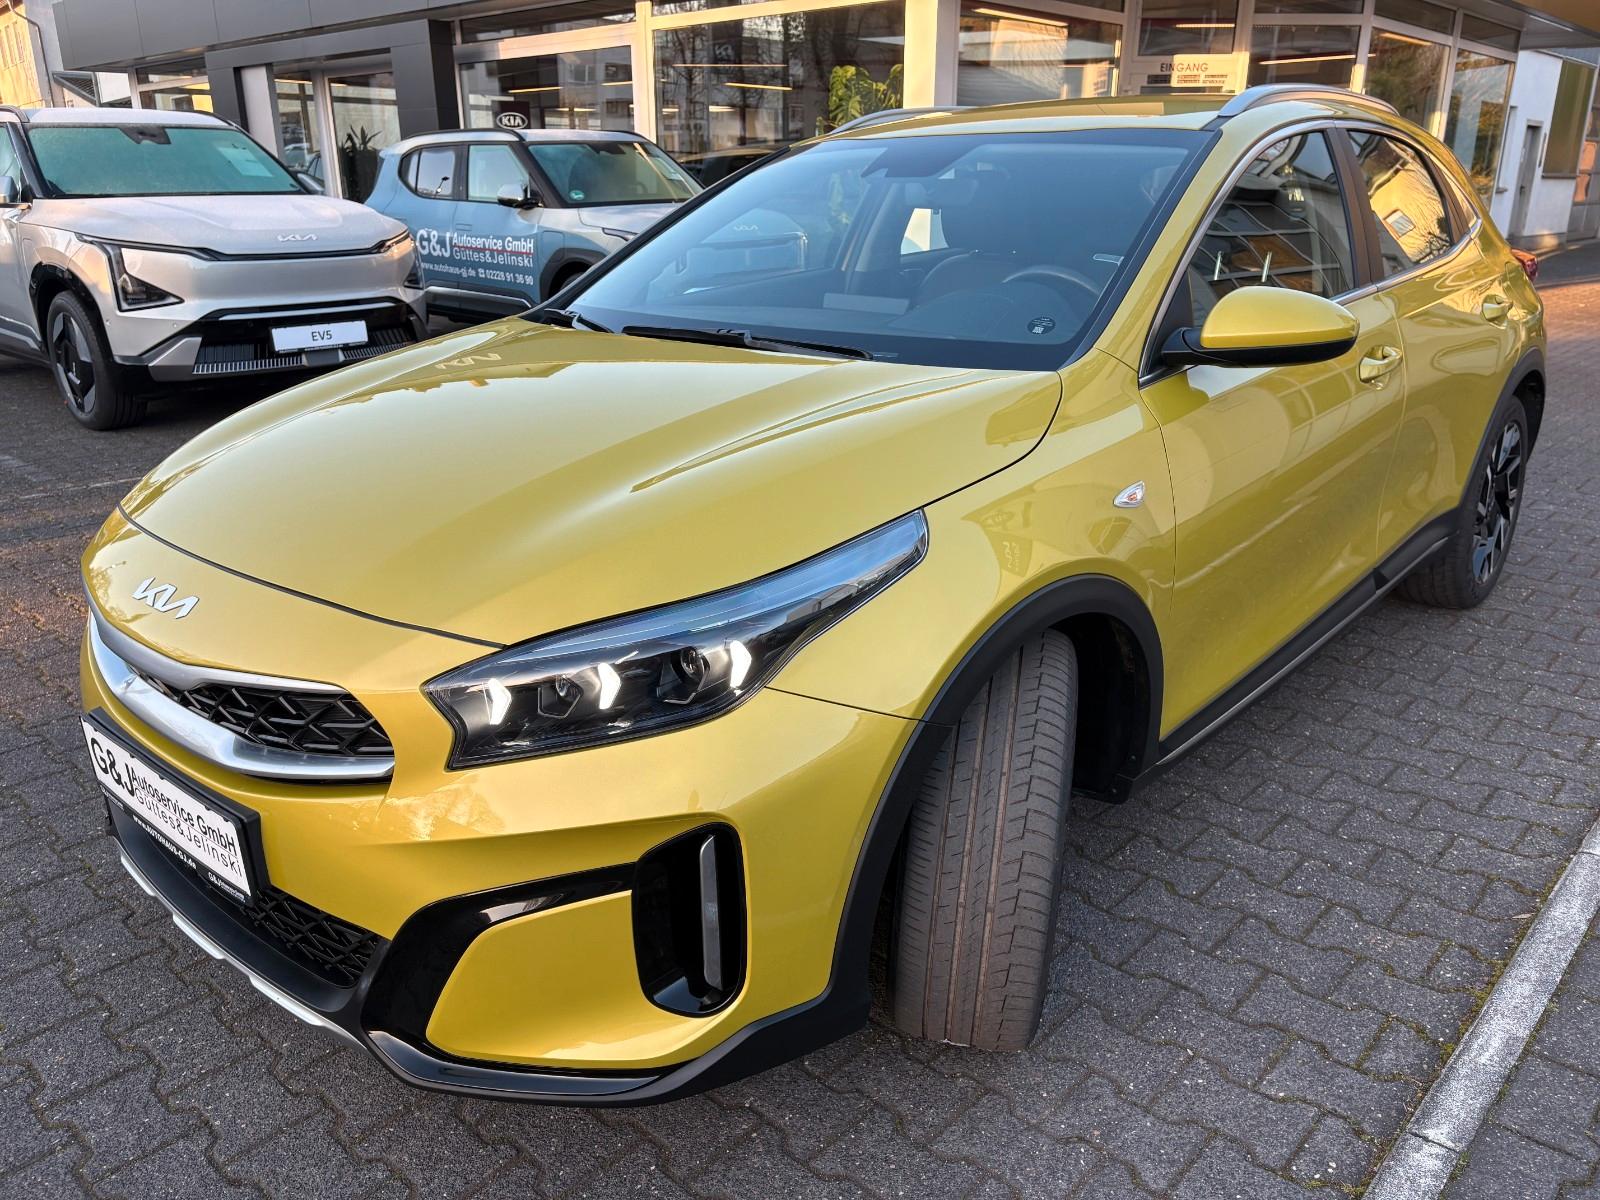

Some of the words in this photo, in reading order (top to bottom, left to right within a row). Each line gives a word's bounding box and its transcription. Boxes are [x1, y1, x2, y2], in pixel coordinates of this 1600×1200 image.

[1160, 62, 1209, 73] EINGANG
[501, 115, 523, 127] KIA
[416, 229, 451, 258] G&J
[452, 232, 503, 250] Autoservice
[505, 237, 535, 253] GmbH
[506, 271, 514, 283] 91
[311, 330, 333, 342] EV5
[90, 737, 135, 797] G&J
[132, 767, 194, 827] Autoservice
[196, 814, 238, 856] GmbH
